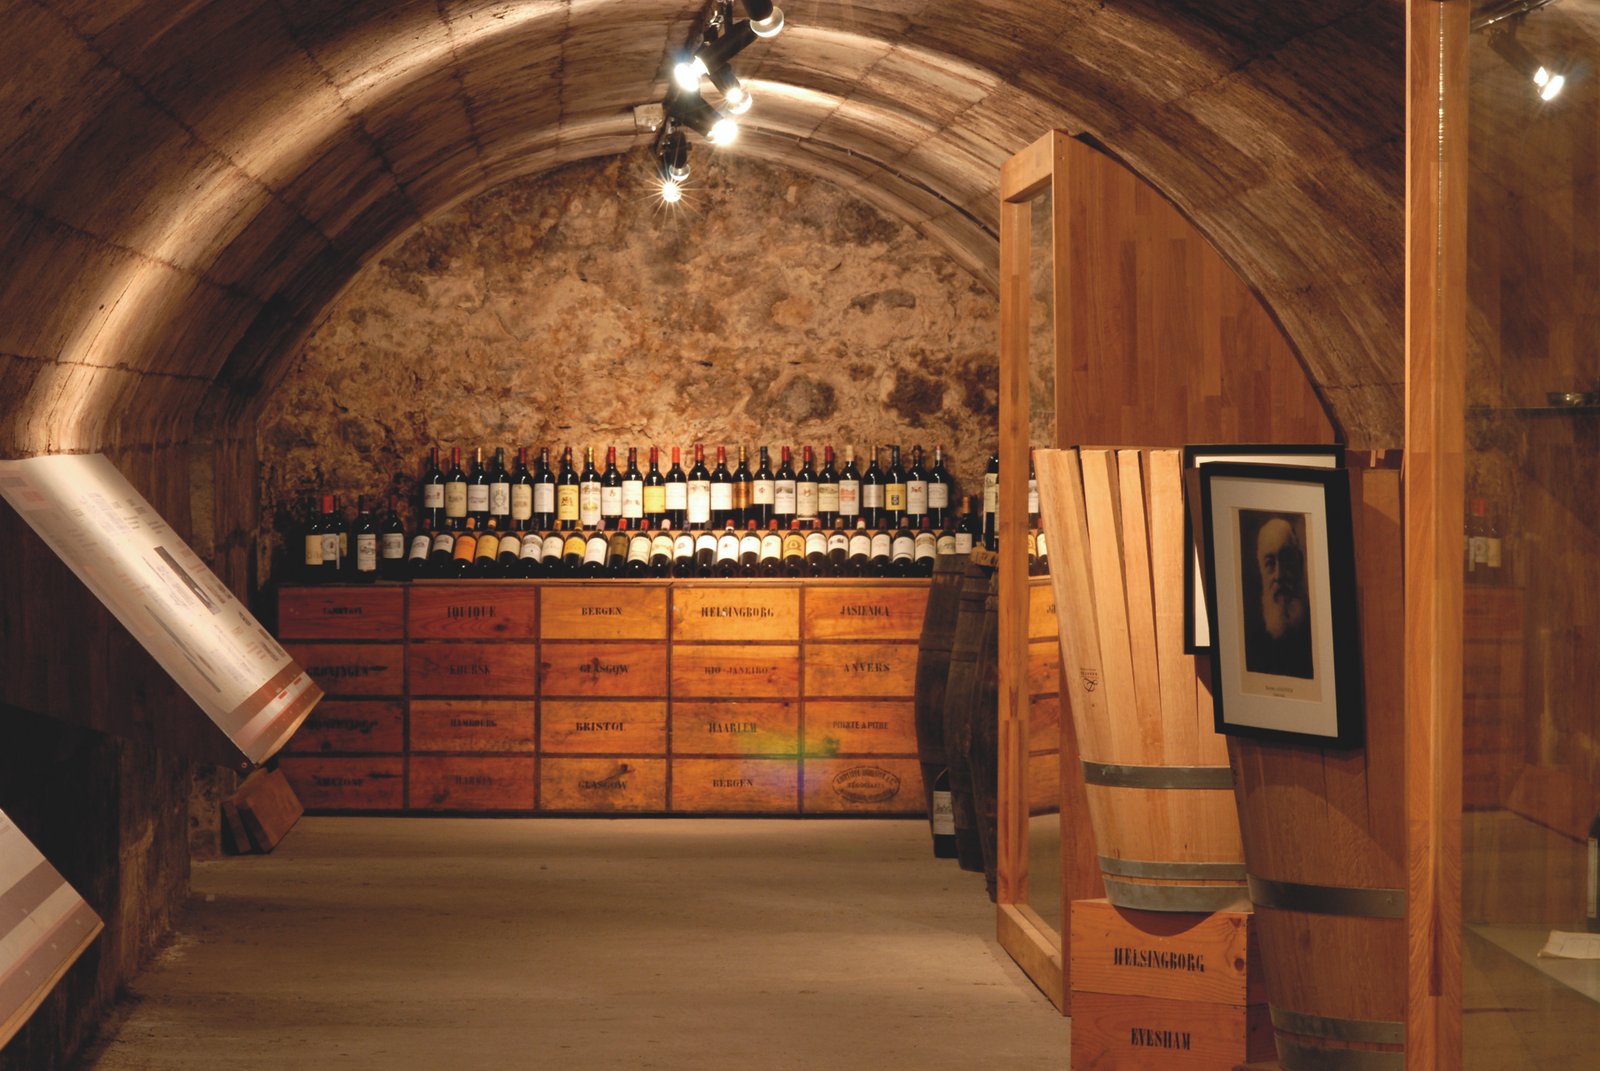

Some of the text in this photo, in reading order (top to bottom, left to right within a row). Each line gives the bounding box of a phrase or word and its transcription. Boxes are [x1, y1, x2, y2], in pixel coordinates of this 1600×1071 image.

[581, 607, 622, 616] BERGEN
[700, 607, 774, 618] HELSINGBORG
[579, 664, 629, 675] GLASGOW
[843, 663, 890, 673] ANVERS
[575, 721, 624, 732] BRISTOL
[708, 722, 757, 734] HAARLEM
[712, 778, 754, 788] BERGEN
[1113, 947, 1205, 973] HELSINGBORG
[1131, 1028, 1191, 1050] EVESHAM
